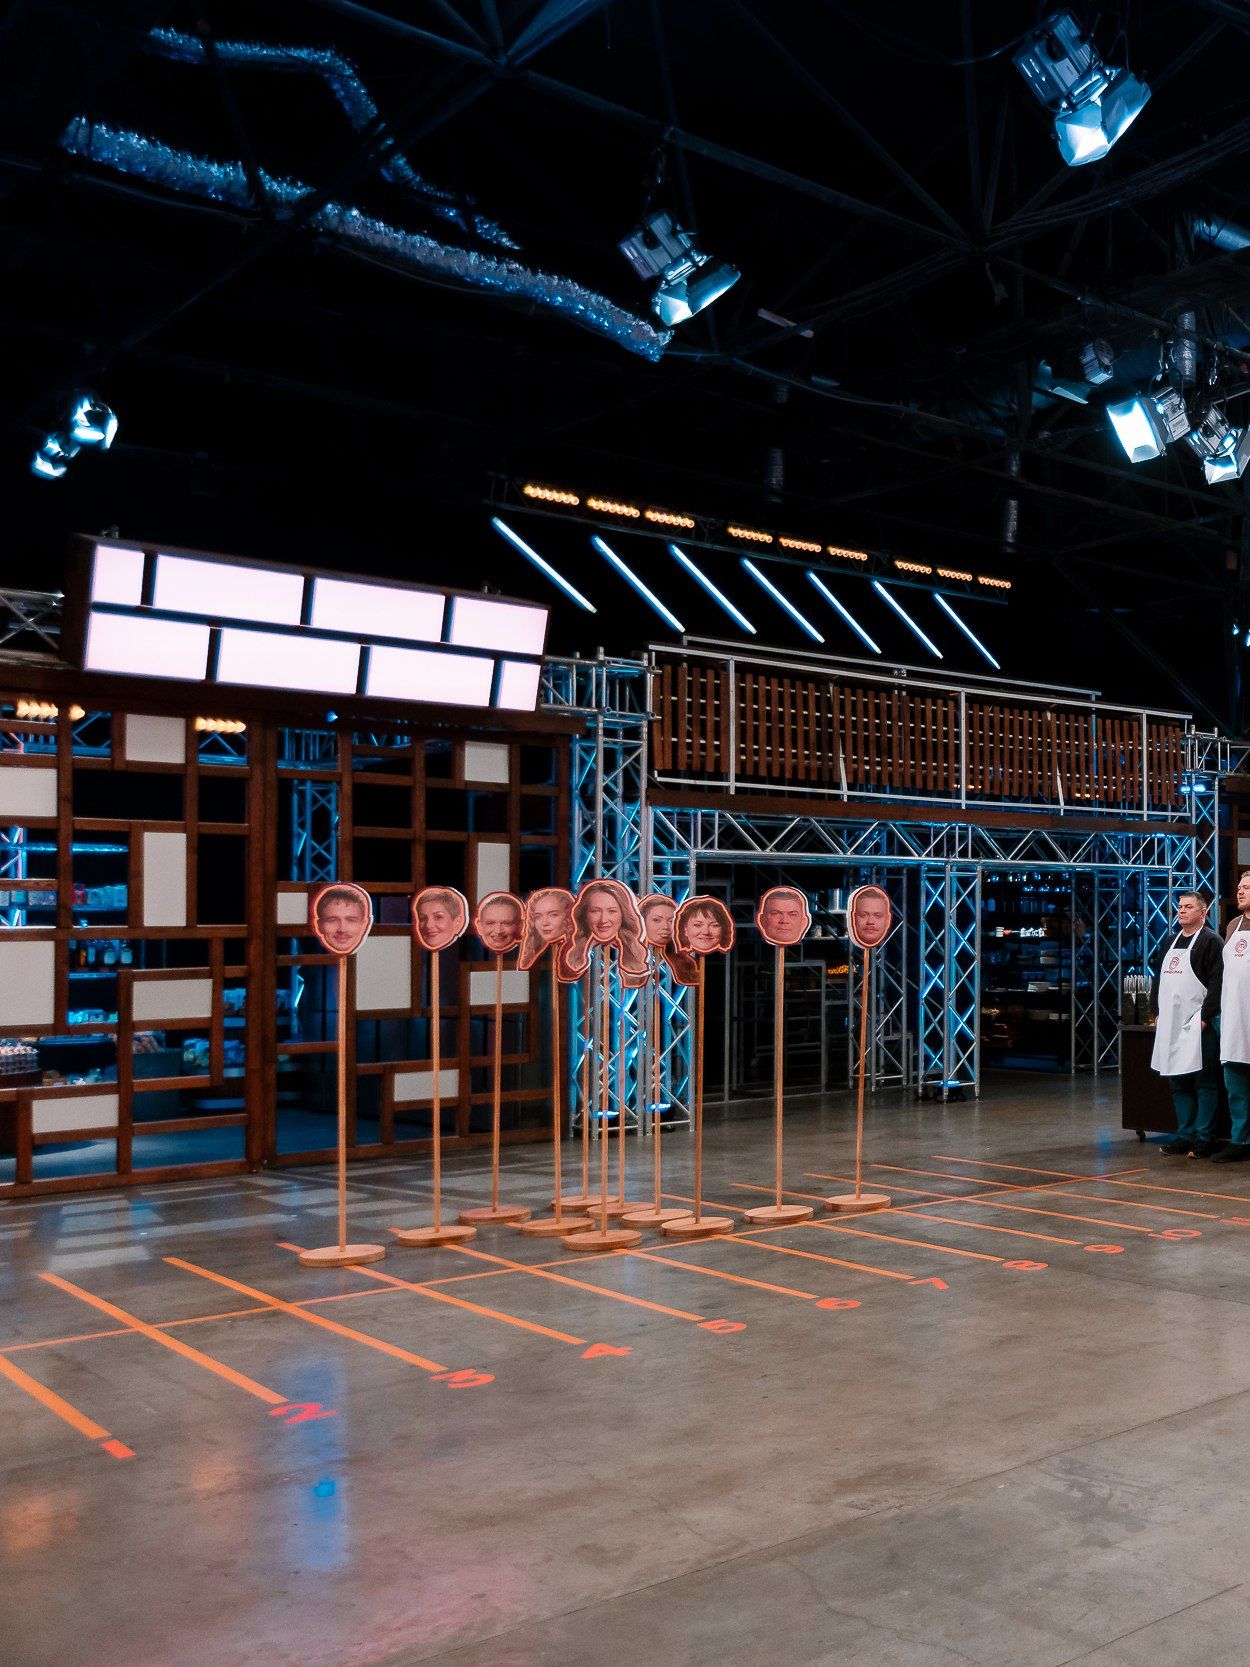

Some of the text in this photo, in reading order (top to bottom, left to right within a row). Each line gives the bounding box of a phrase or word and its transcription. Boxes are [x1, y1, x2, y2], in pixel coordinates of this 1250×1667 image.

[1002, 1259, 1049, 1271] 8
[907, 1277, 949, 1290] 7
[815, 1298, 861, 1310] 6
[696, 1319, 747, 1333] 5
[581, 1343, 632, 1360] 4
[431, 1368, 496, 1388] 3
[268, 1402, 338, 1424] 2
